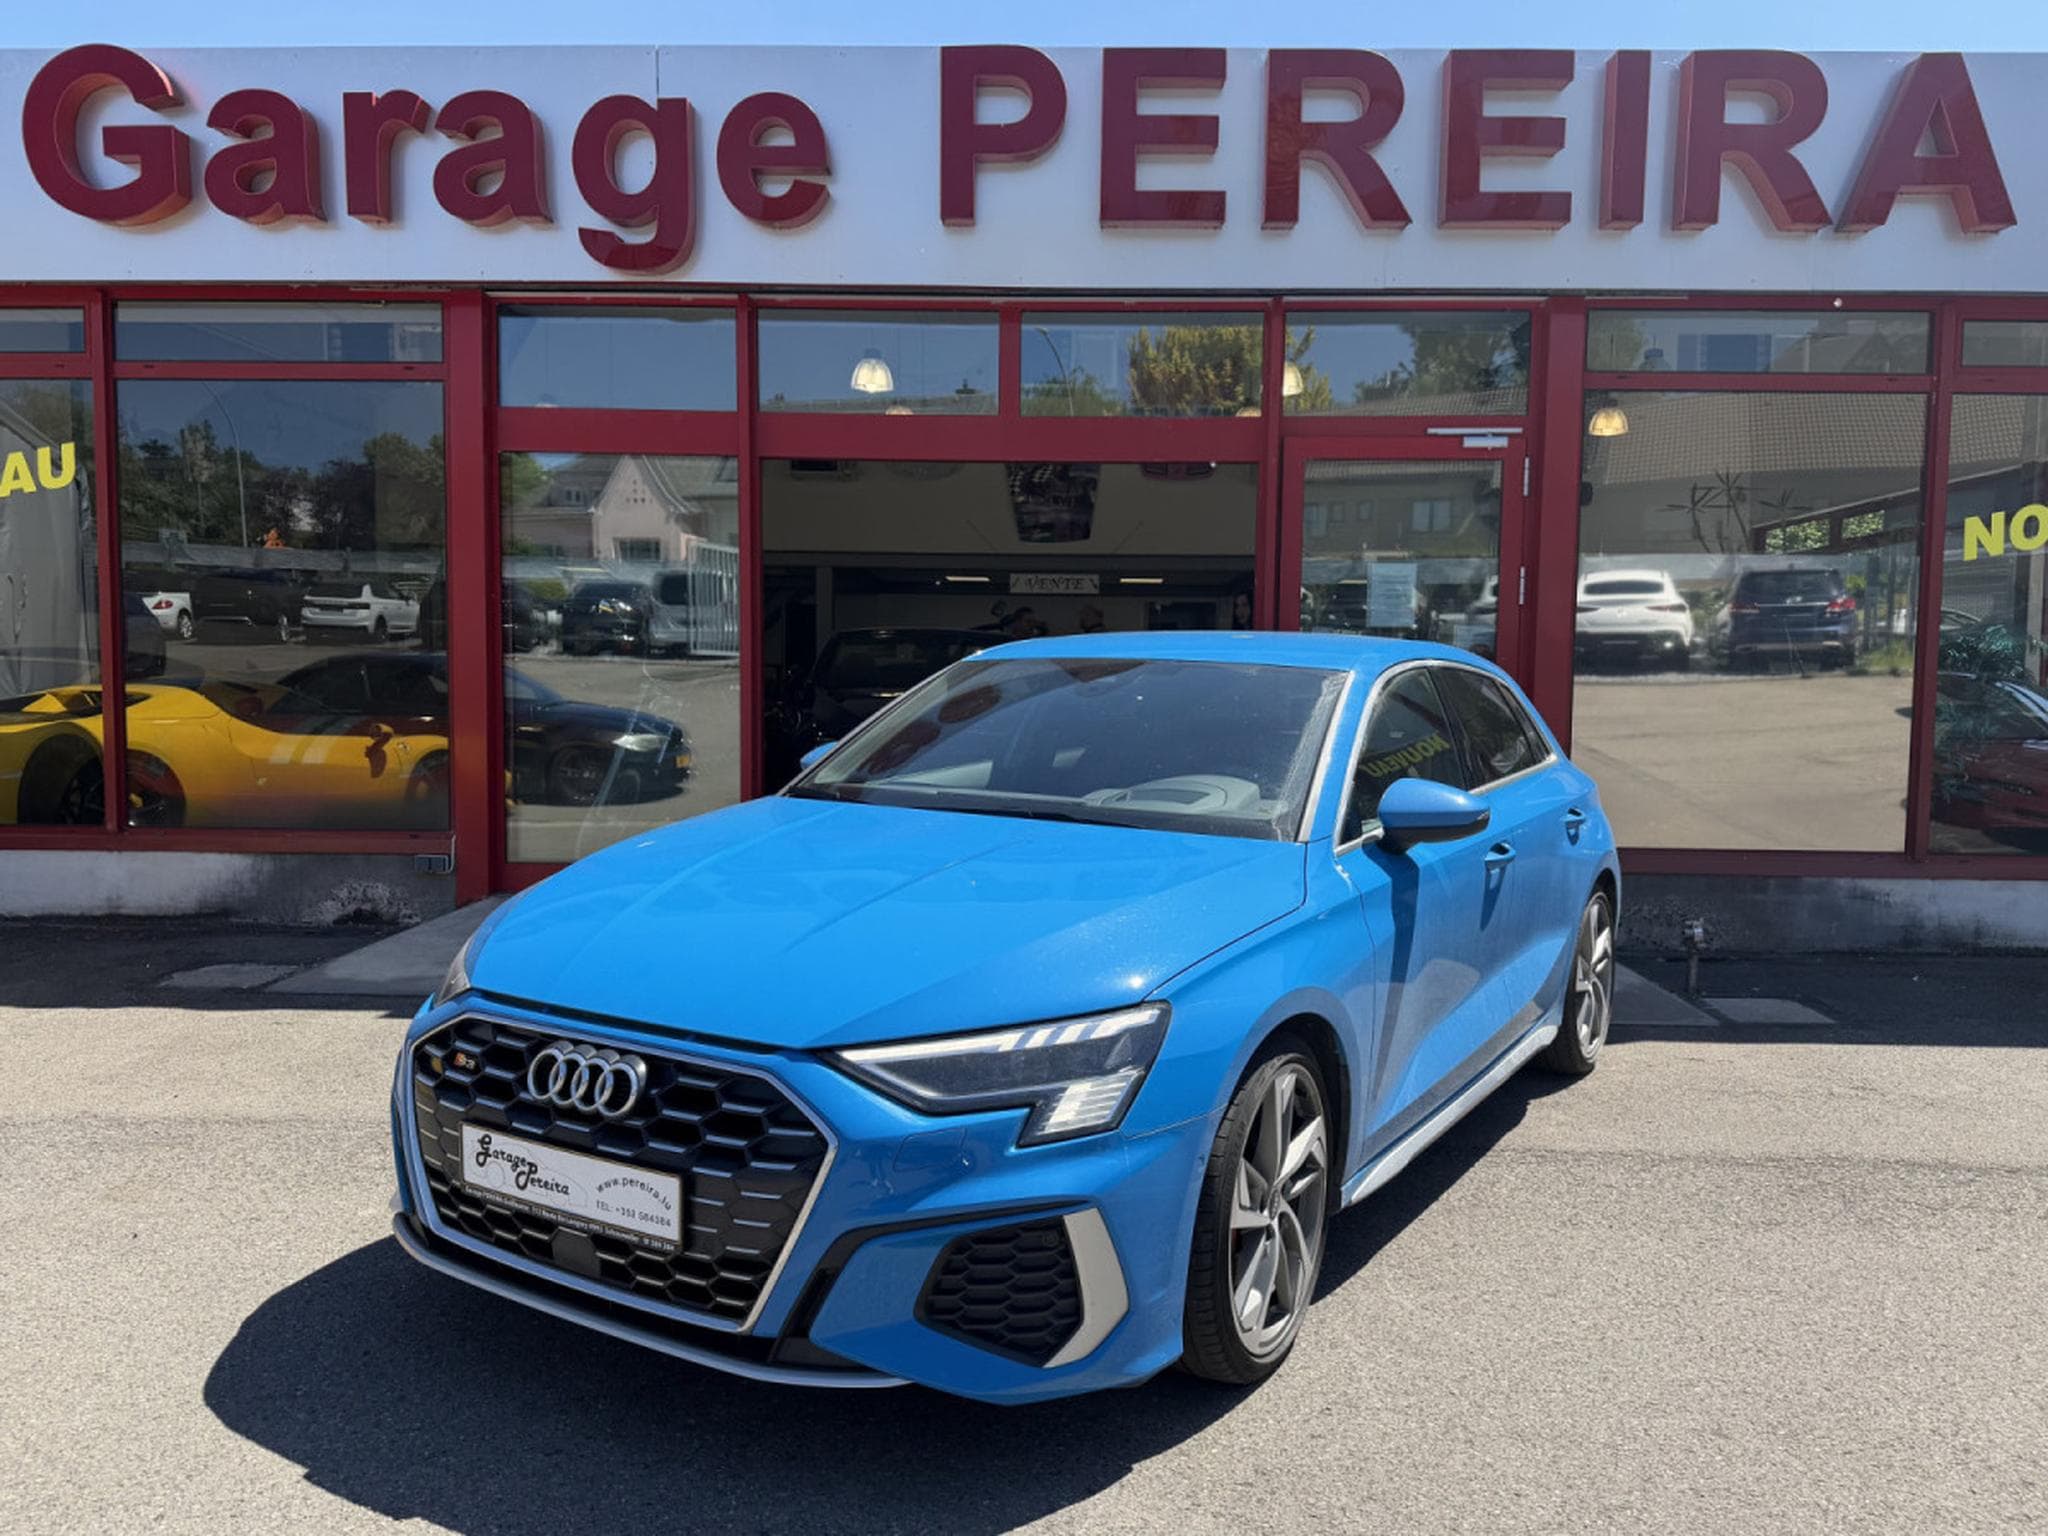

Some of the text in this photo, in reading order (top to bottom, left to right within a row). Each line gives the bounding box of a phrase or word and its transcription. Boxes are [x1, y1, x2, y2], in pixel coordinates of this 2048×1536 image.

[22, 43, 2018, 275] Garage PEREIRA
[476, 1133, 527, 1172] Garage
[515, 1161, 570, 1195] Pereira
